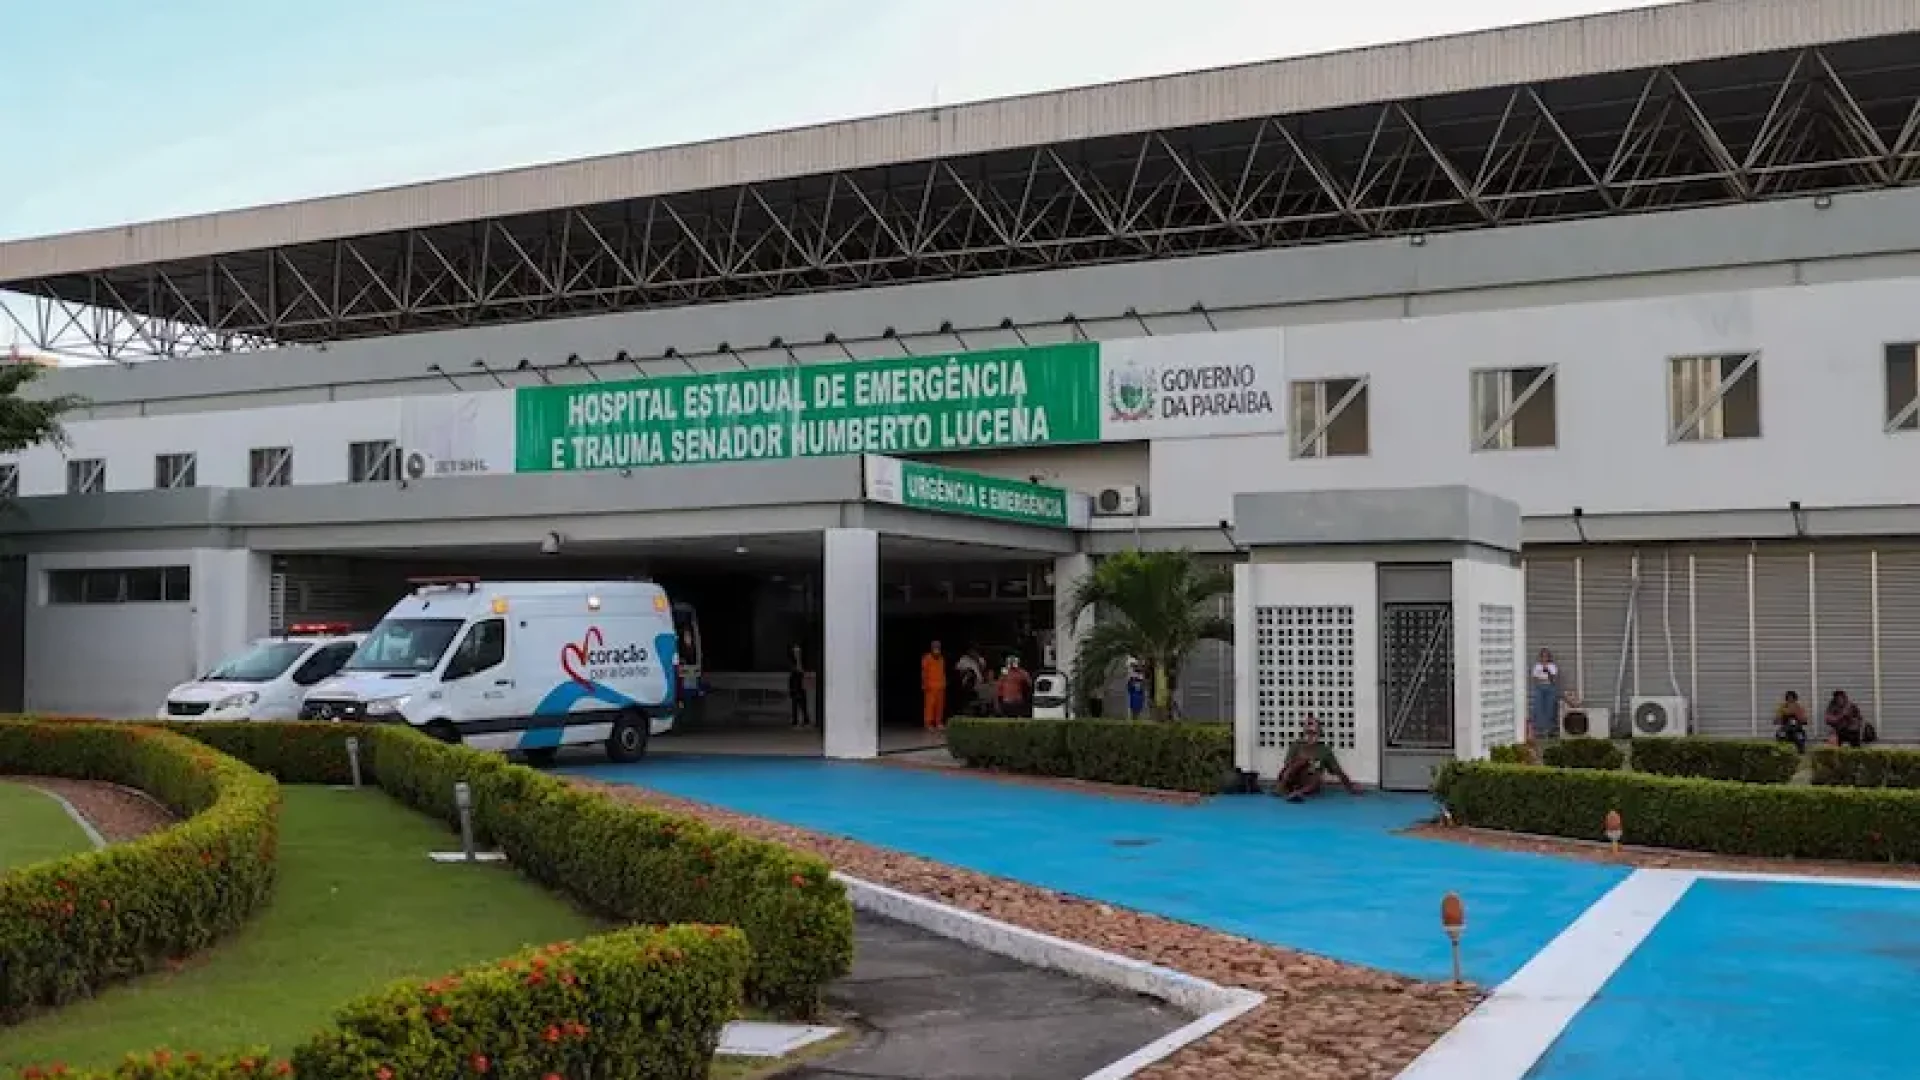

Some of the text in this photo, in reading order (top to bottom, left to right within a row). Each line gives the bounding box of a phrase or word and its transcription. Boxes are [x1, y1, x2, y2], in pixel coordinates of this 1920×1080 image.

[1161, 364, 1255, 391] GOVERNO
[568, 357, 1027, 426] HOSPITAL ESTADUAL DE EMERGÊNCIA
[1161, 396, 1189, 418] DA
[552, 406, 1049, 468] E TRAUMA SENADOR HUMBERTO LUCENA
[979, 486, 989, 508] E
[589, 643, 649, 665] coração
